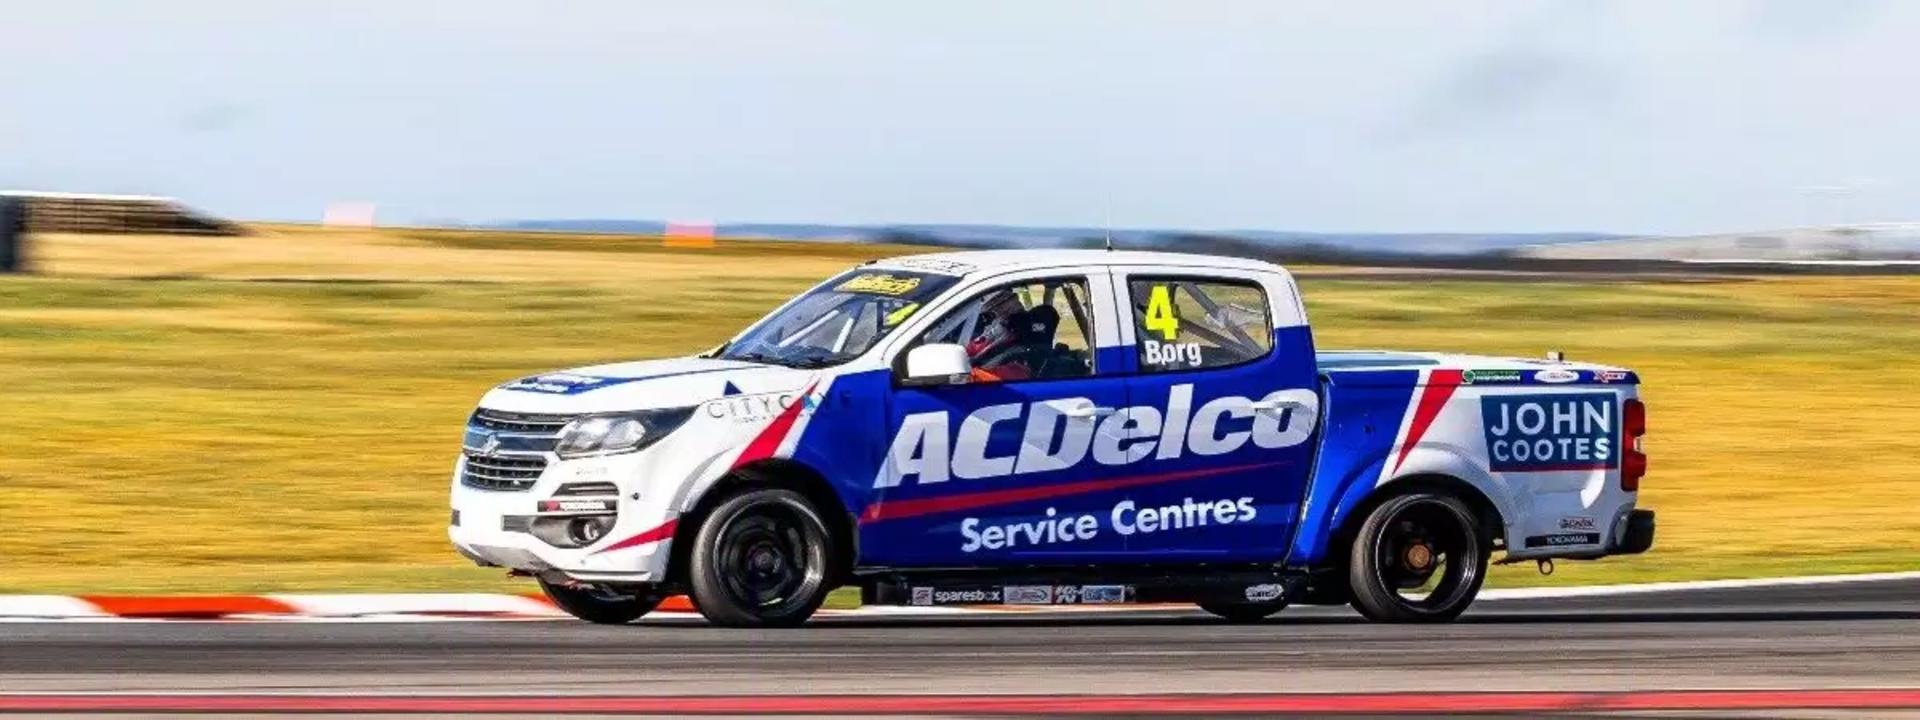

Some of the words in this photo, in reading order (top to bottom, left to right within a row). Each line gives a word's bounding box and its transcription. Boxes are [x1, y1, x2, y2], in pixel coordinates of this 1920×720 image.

[1145, 285, 1179, 340] 4
[1144, 340, 1202, 367] Borg
[873, 383, 1320, 489] ACDelco
[1491, 401, 1611, 436] JOHN
[1493, 437, 1611, 462] COOTES
[960, 507, 1099, 553] Service
[1111, 496, 1257, 535] Centres
